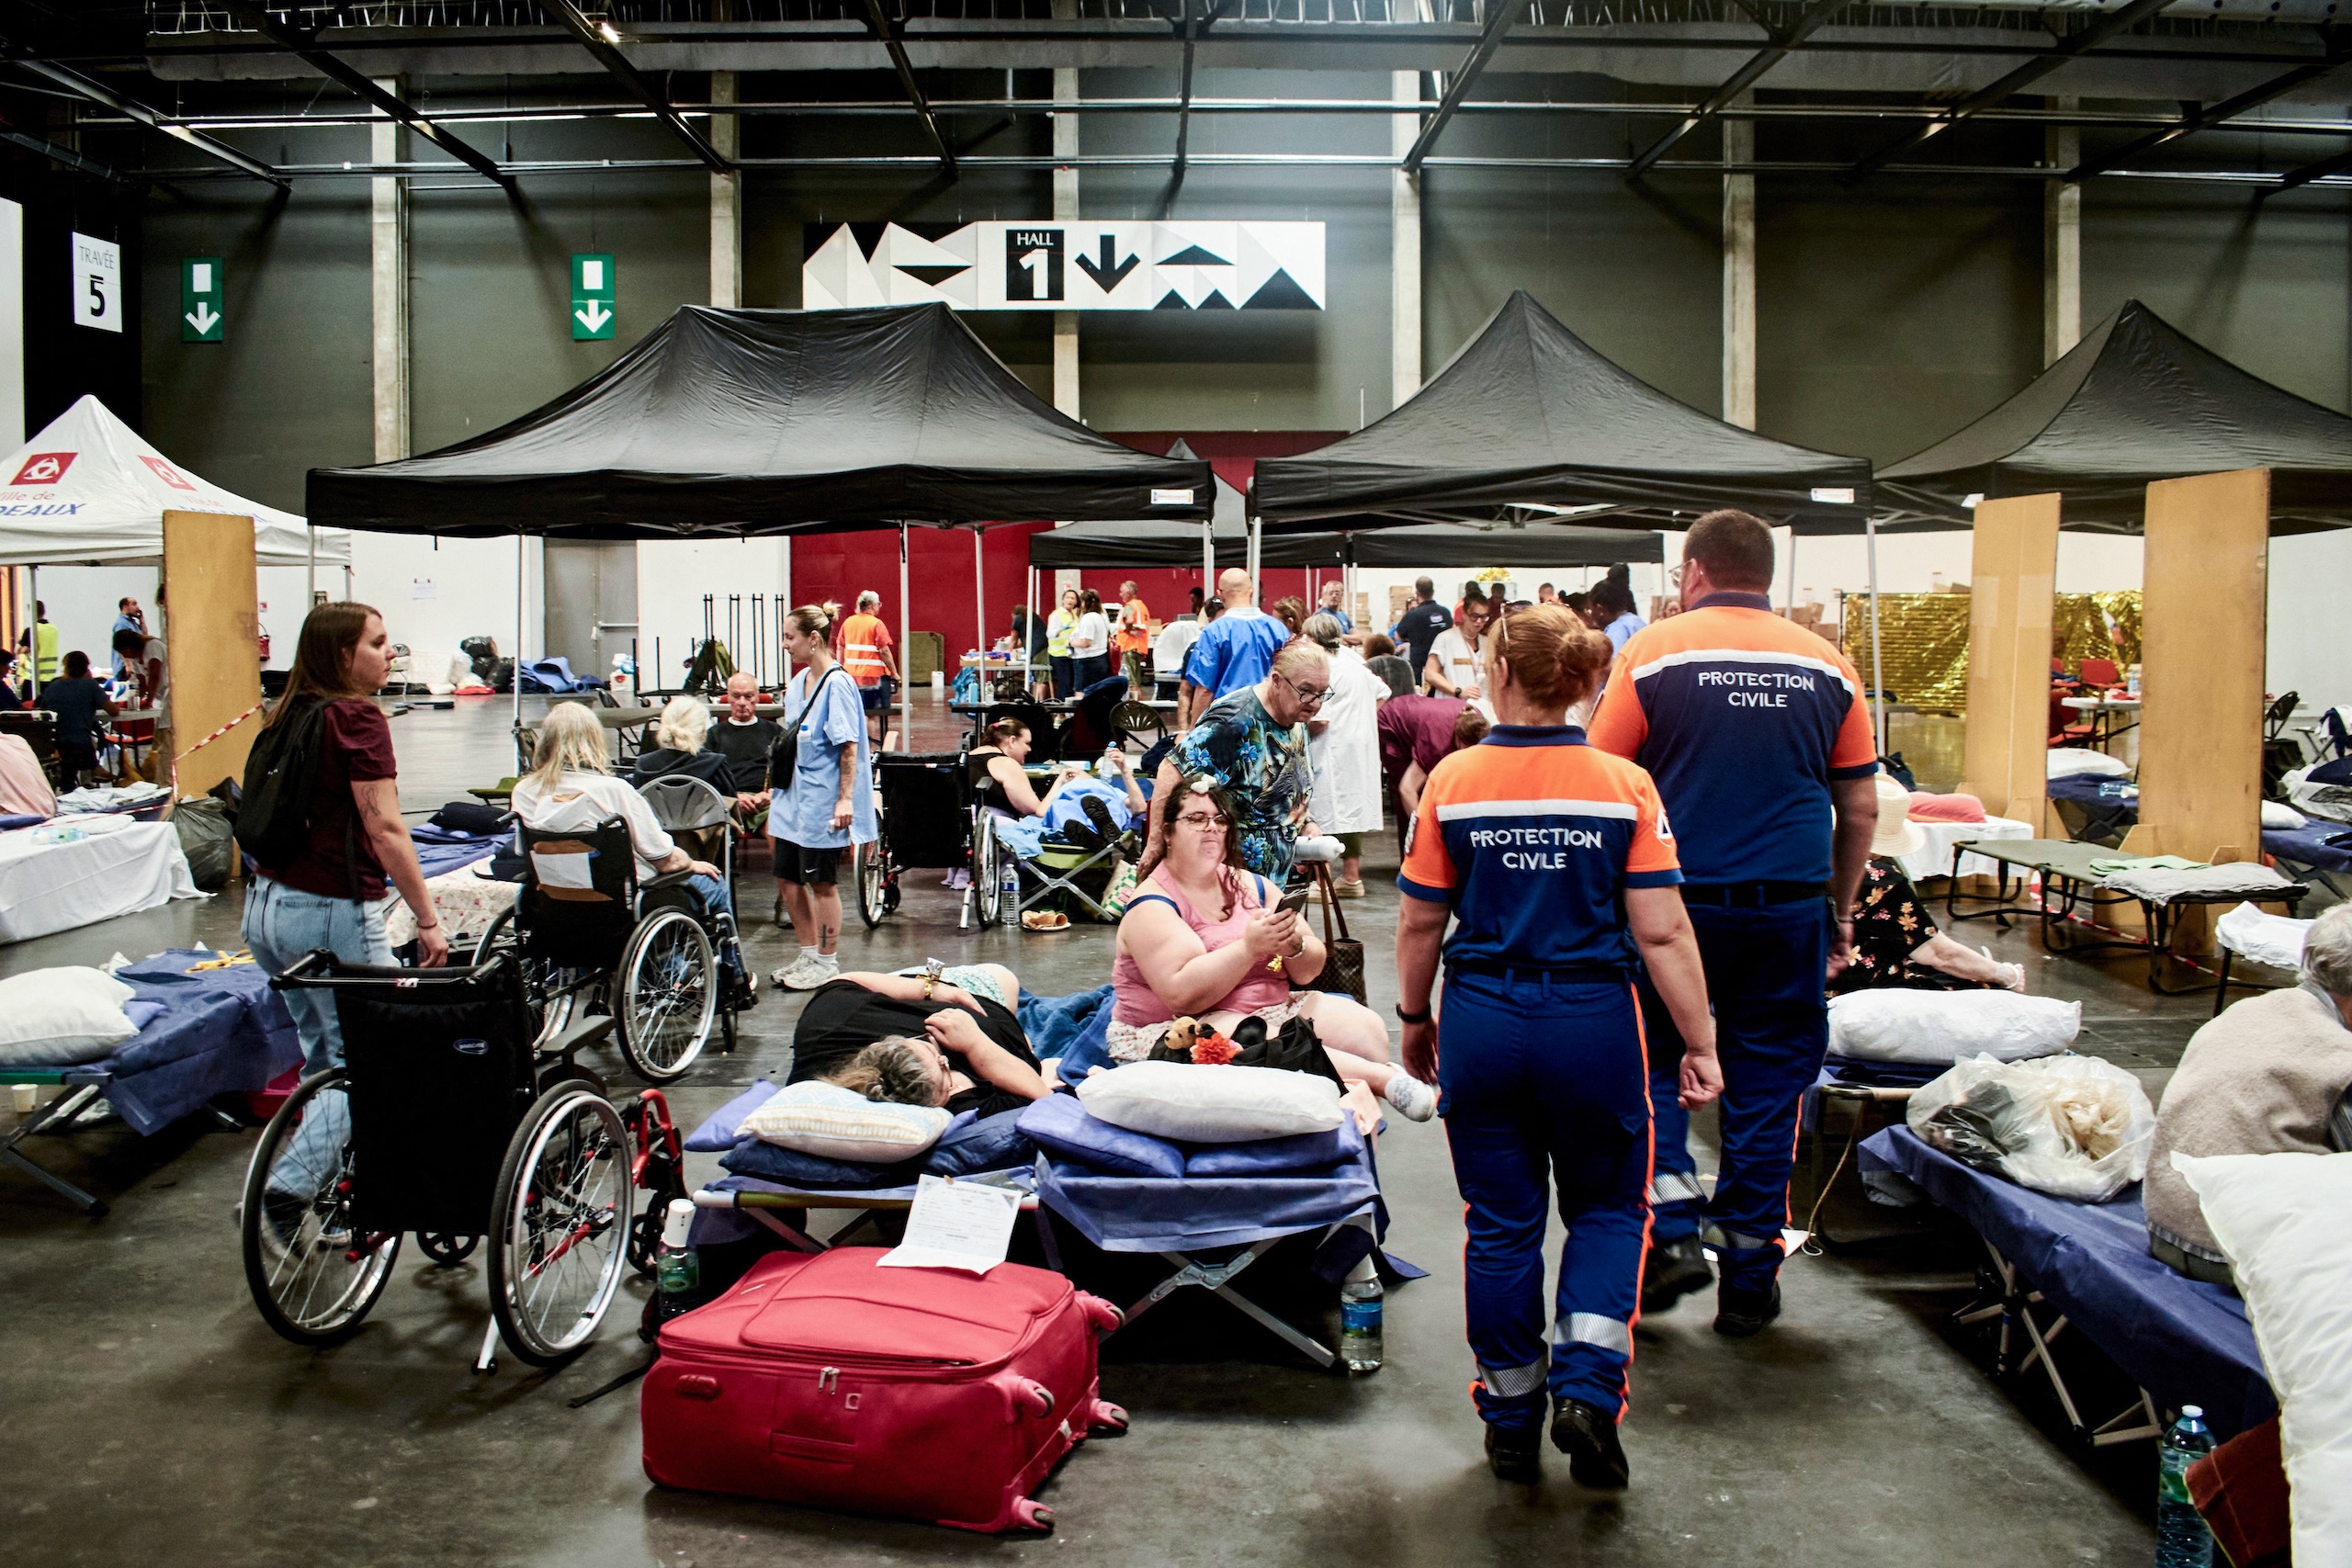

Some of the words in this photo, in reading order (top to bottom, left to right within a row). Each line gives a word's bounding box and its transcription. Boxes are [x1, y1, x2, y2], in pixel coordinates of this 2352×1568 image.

[1017, 232, 1054, 246] HALL
[79, 245, 115, 270] TRAVÉE
[1018, 248, 1048, 299] 1
[89, 274, 106, 318] 5
[32, 491, 55, 501] de
[1698, 671, 1815, 692] PROTECTION
[1727, 691, 1789, 708] CIVILE
[1469, 828, 1603, 850] PROTECTION
[1501, 852, 1568, 871] CIVILE
